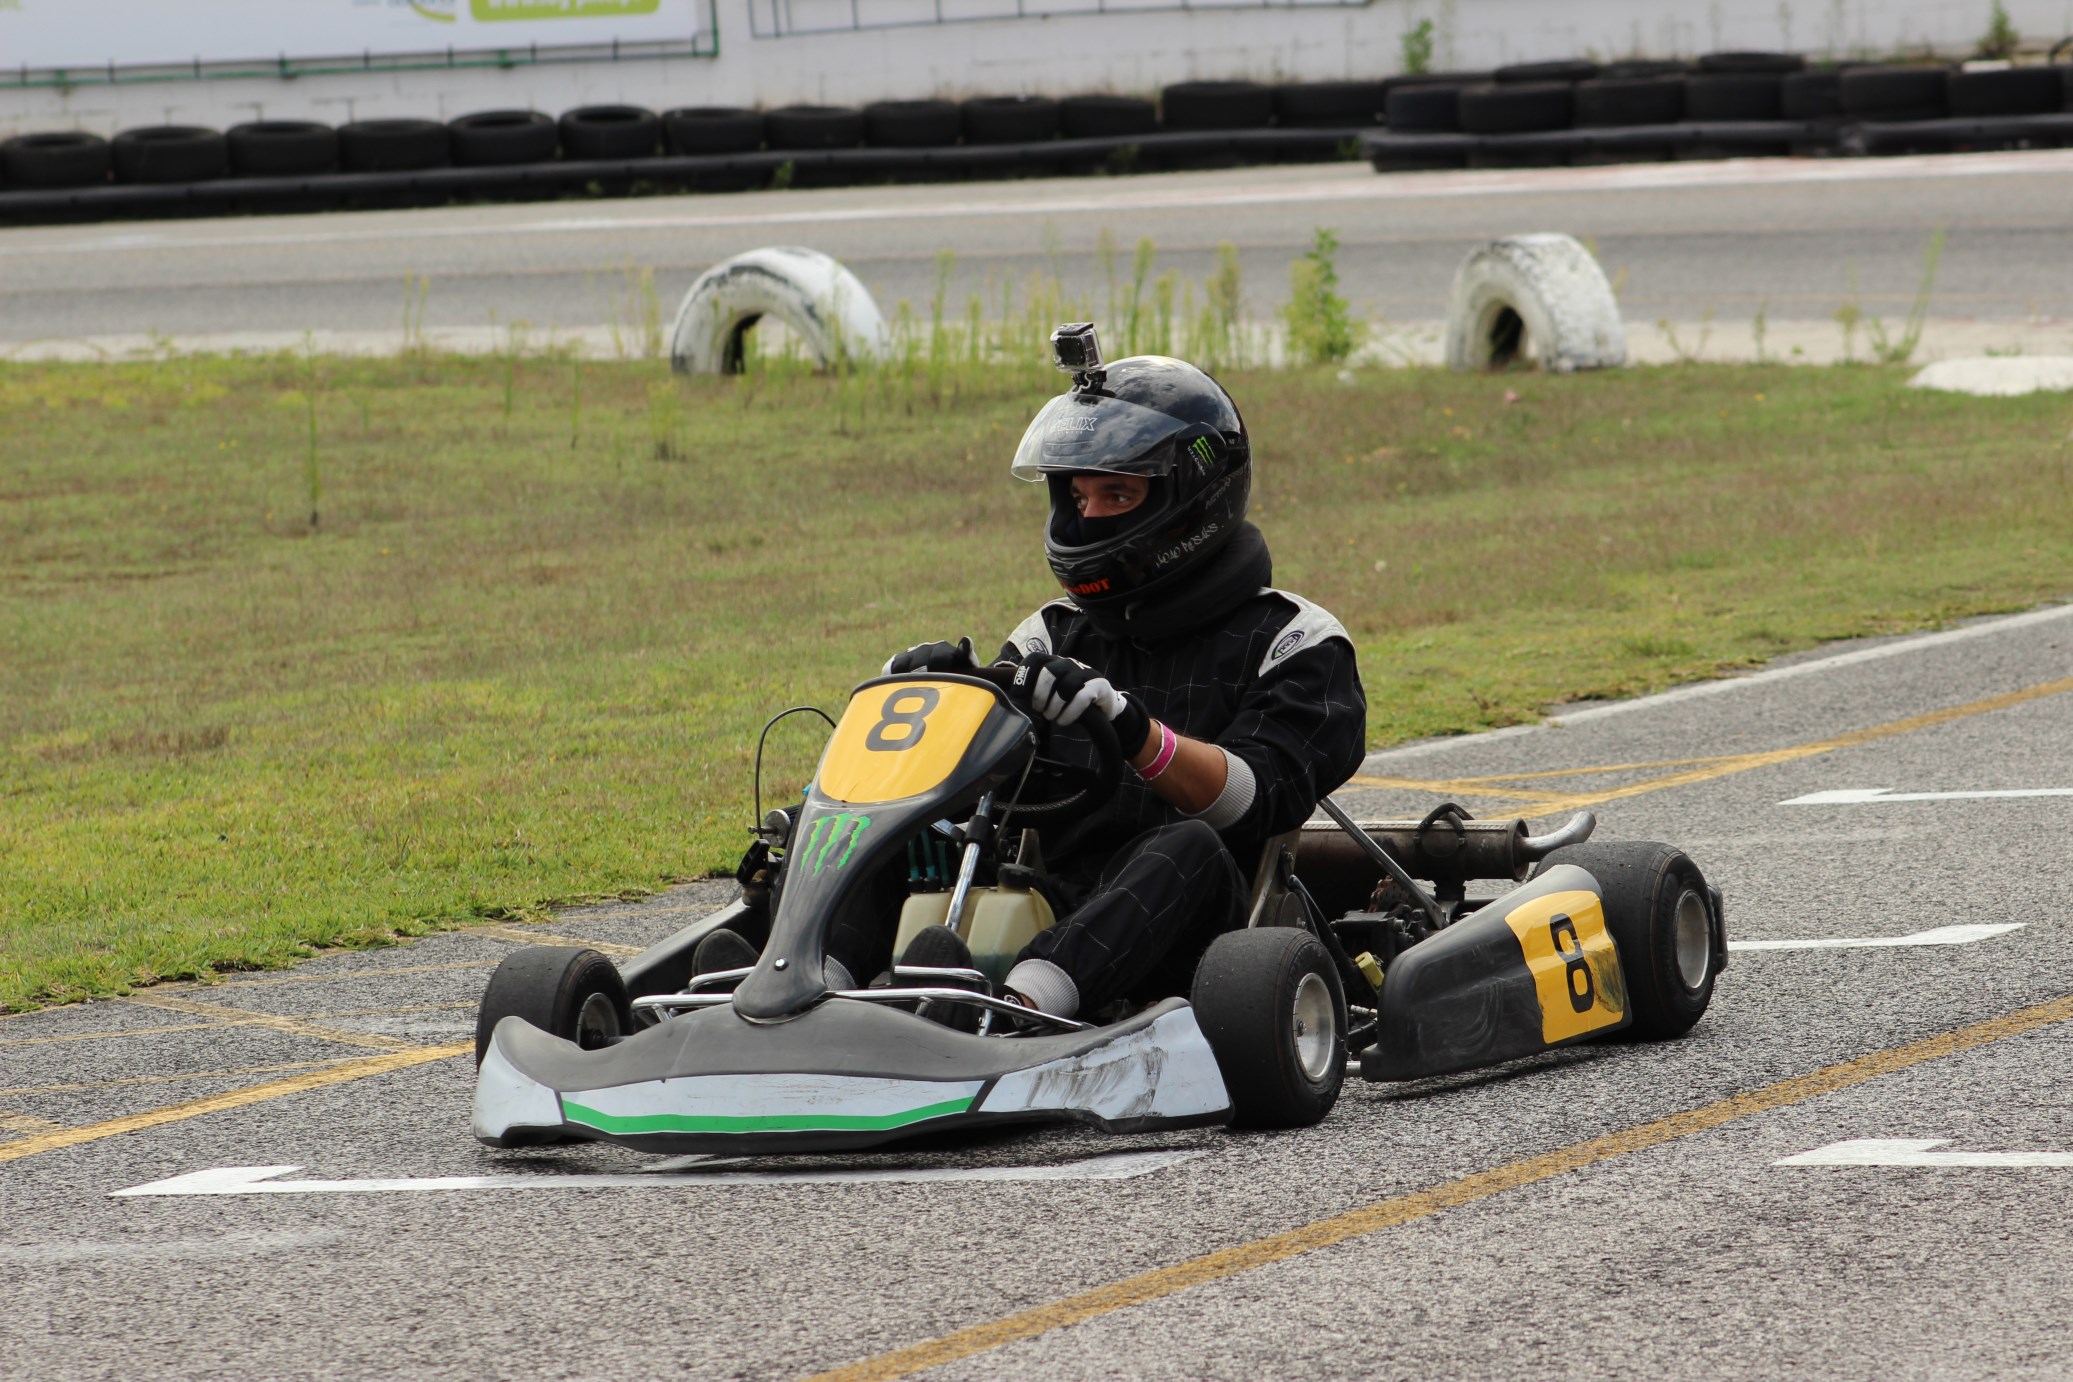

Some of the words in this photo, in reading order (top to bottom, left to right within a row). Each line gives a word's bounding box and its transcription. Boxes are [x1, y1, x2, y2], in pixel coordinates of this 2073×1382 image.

[1014, 665, 1027, 685] OMP
[865, 687, 940, 751] 8
[1550, 913, 1594, 1013] 8
